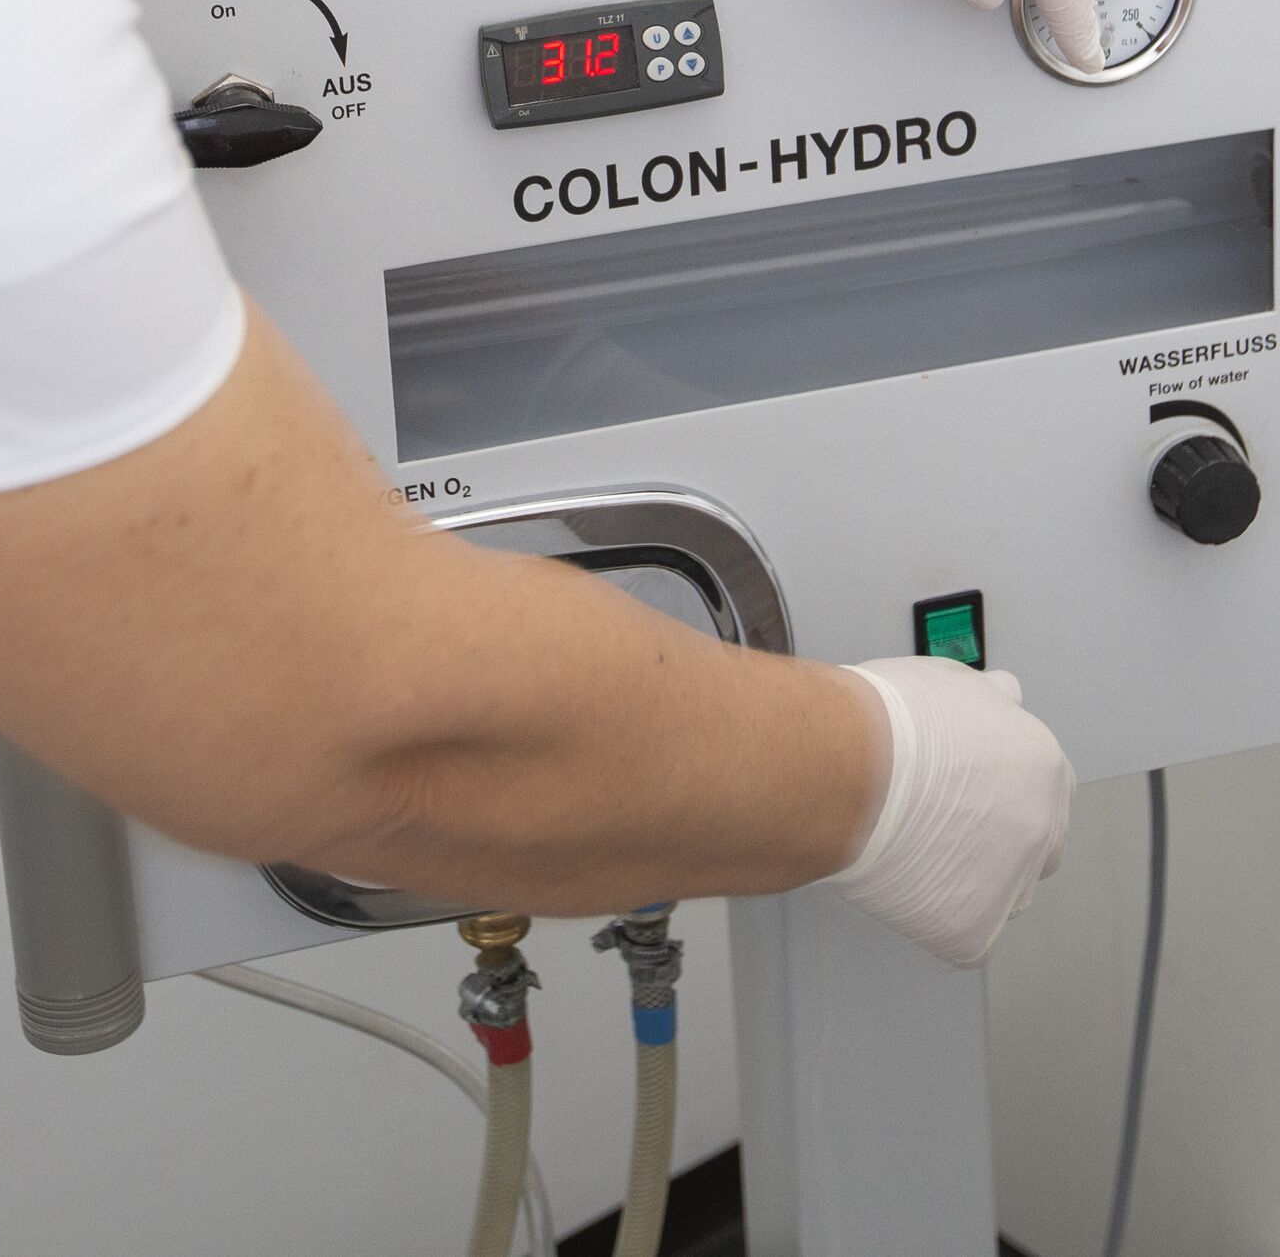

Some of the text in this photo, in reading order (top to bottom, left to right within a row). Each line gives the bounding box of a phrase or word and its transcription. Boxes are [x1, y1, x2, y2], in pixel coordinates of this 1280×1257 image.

[210, 4, 236, 19] On
[598, 15, 614, 26] TLZ
[1122, 8, 1140, 22] 250
[653, 33, 661, 44] U
[541, 31, 621, 85] 31.2
[657, 64, 665, 75] P
[322, 72, 373, 98] AUS
[331, 102, 367, 120] OFF
[1118, 333, 1278, 376] WASSERFLUSS
[1149, 369, 1250, 397] Flow of water
[382, 481, 436, 506] GEN
